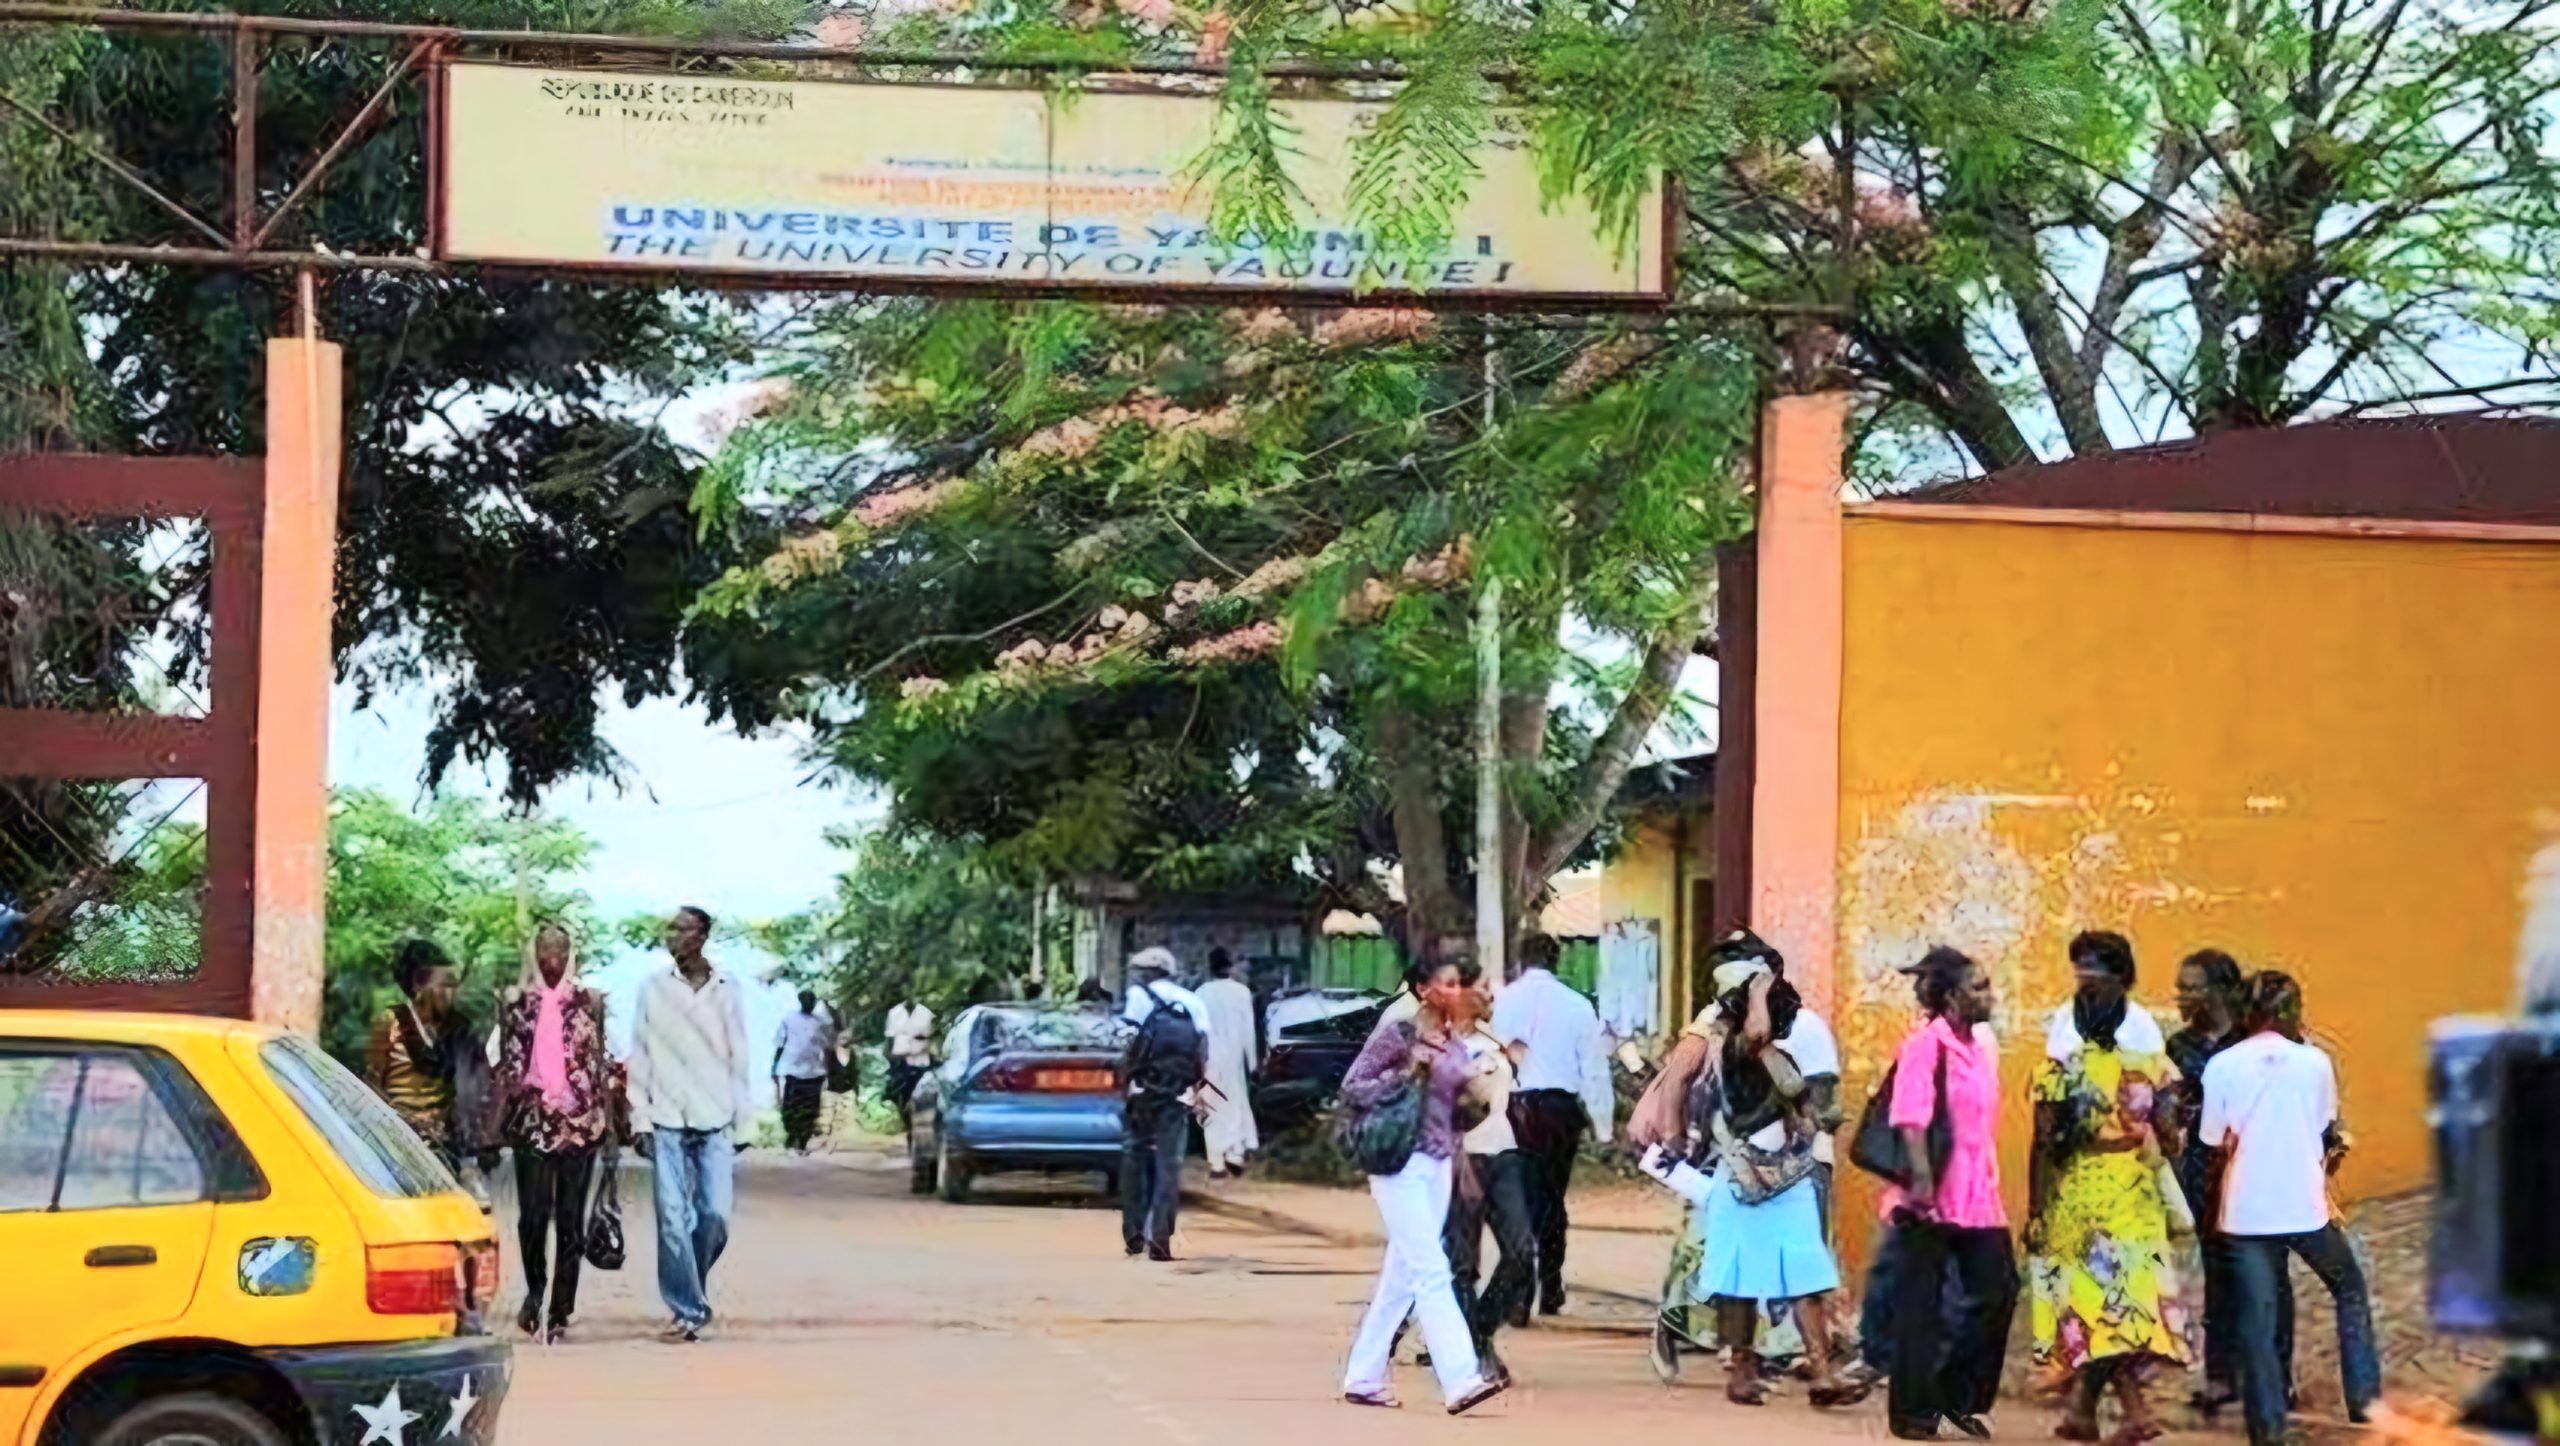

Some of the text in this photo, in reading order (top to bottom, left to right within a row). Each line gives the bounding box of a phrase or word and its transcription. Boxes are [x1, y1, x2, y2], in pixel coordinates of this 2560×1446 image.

[612, 206, 1013, 244] UNIVERSITE
[1038, 221, 1120, 247] DE
[605, 233, 707, 258] THE
[736, 238, 1086, 272] UNIVERSITY
[1104, 252, 1182, 274] OF
